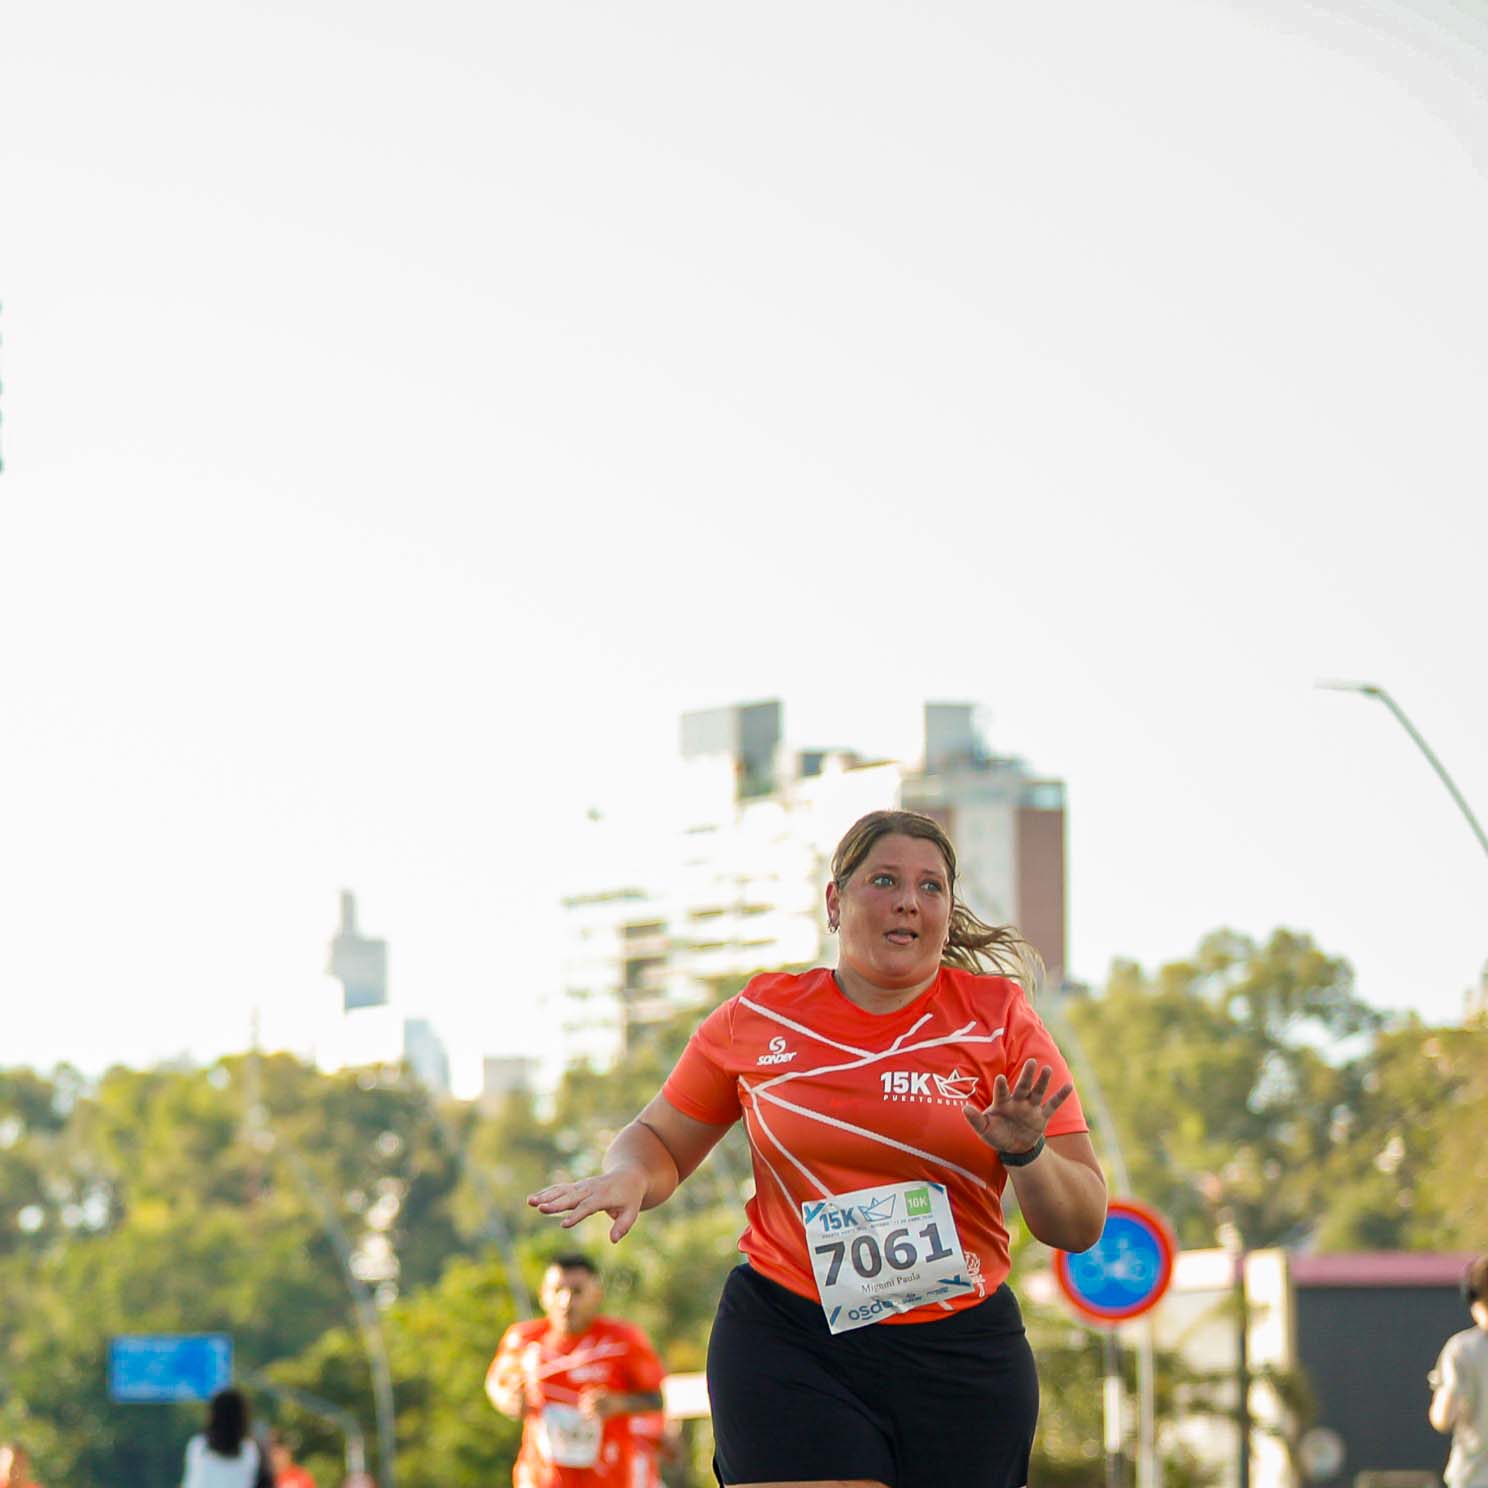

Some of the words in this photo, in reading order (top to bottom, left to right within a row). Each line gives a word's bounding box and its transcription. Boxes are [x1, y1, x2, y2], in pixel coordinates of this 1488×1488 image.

[881, 1072, 931, 1095] 15K
[884, 1094, 932, 1104] PUERTO
[908, 1197, 928, 1209] 10K
[819, 1207, 858, 1232] 15K
[815, 1222, 953, 1287] 7061
